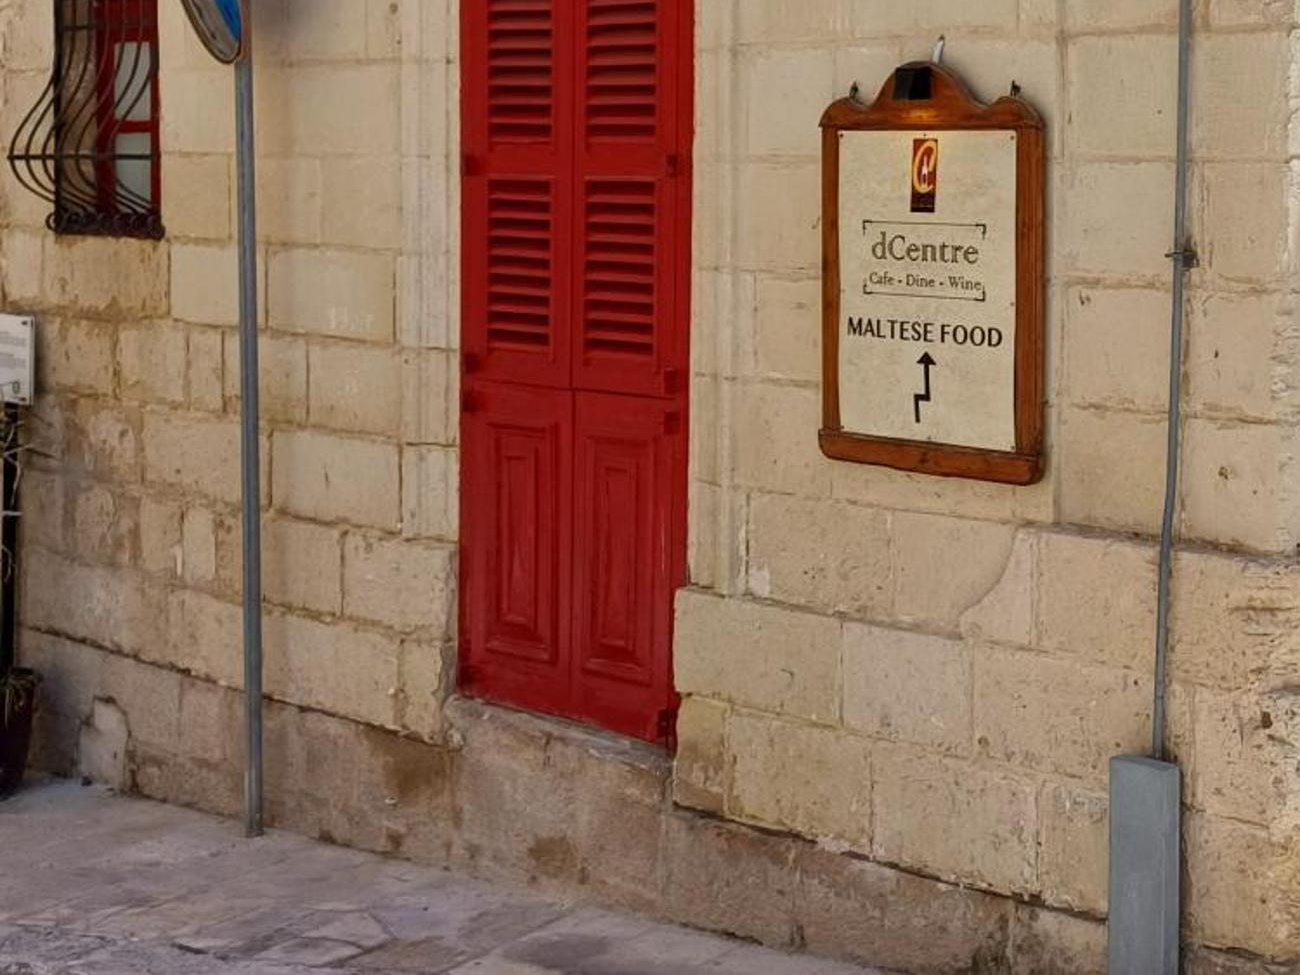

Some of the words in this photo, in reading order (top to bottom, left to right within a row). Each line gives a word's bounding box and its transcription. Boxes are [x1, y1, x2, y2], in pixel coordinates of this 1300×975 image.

[871, 231, 979, 264] dCentre
[906, 273, 935, 287] Dine
[948, 275, 982, 291] Wine
[847, 316, 935, 343] MALTESE
[940, 323, 1003, 347] FOOD
